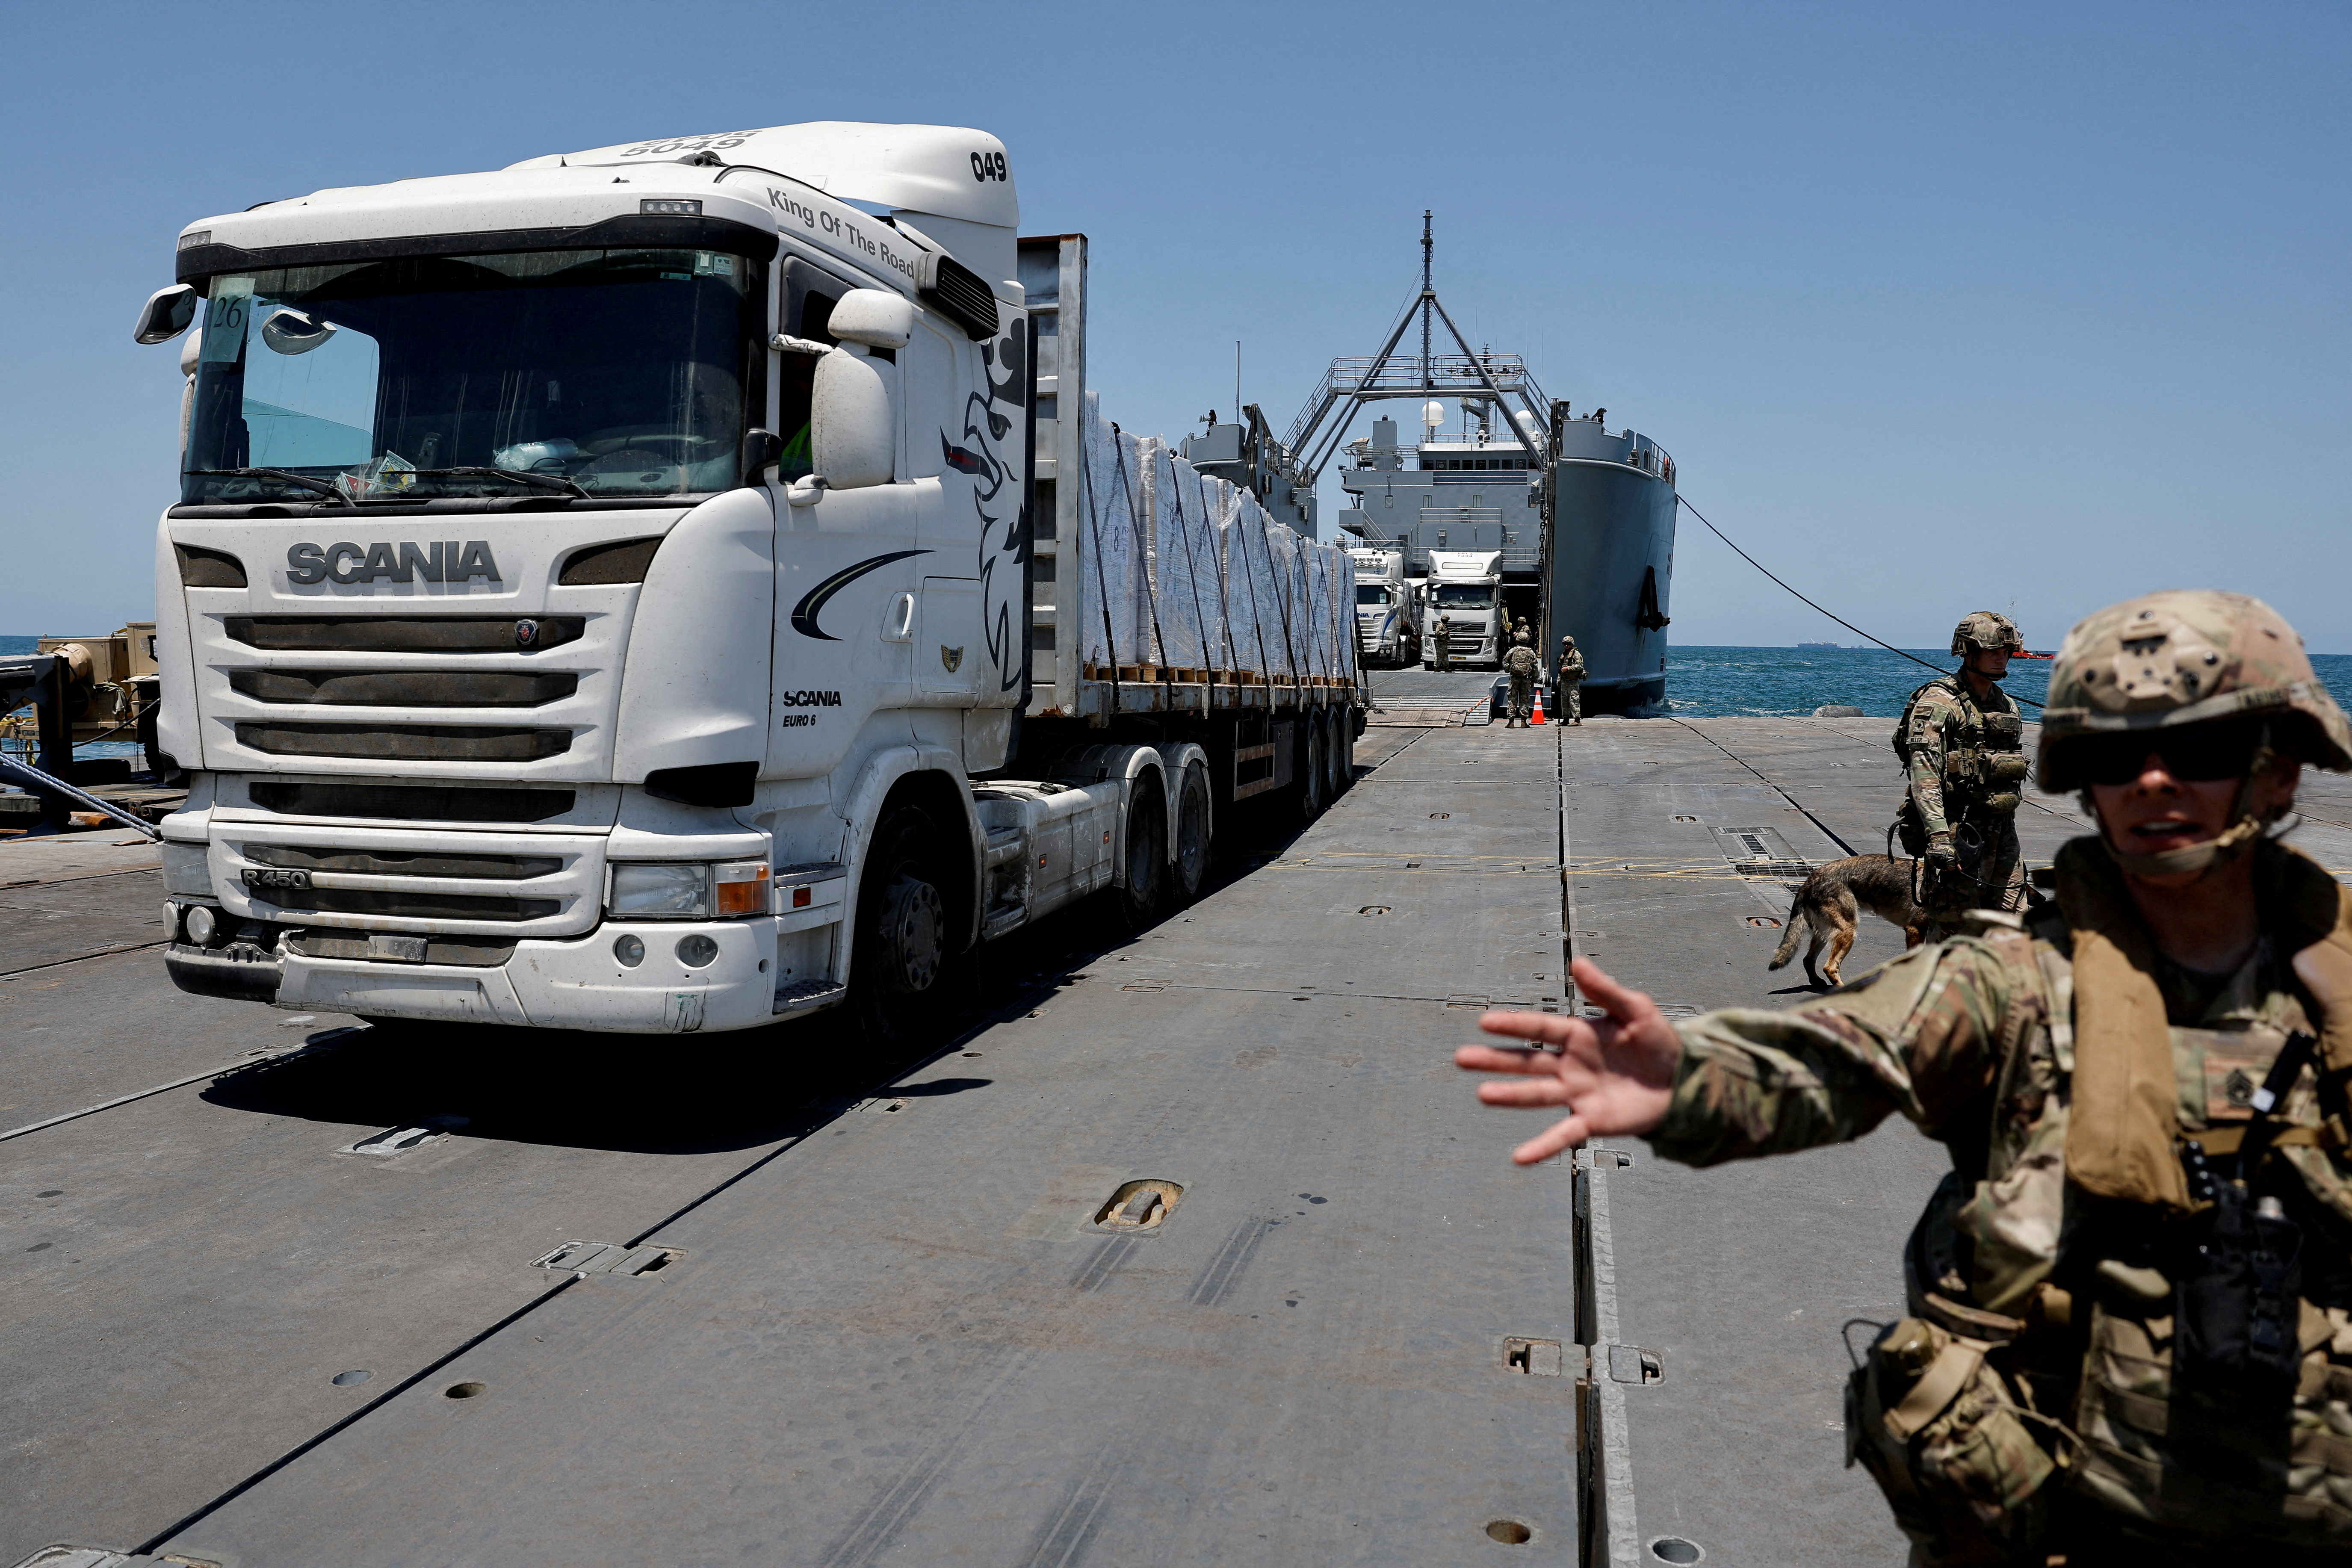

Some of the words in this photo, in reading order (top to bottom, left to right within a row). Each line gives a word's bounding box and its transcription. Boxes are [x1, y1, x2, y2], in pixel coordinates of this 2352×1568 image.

[620, 139, 745, 157] 5049
[970, 151, 1007, 183] 049
[766, 187, 815, 228] King
[820, 211, 841, 237] Of
[845, 222, 876, 256] The
[879, 242, 915, 280] Road
[213, 295, 247, 328] 26
[391, 459, 405, 469] Canada
[1114, 526, 1119, 552] 8
[286, 540, 503, 585] SCANIA
[783, 690, 842, 707] SCANIA
[783, 715, 809, 727] EURO
[810, 714, 816, 726] 6
[243, 870, 260, 886] R
[261, 871, 307, 888] 450
